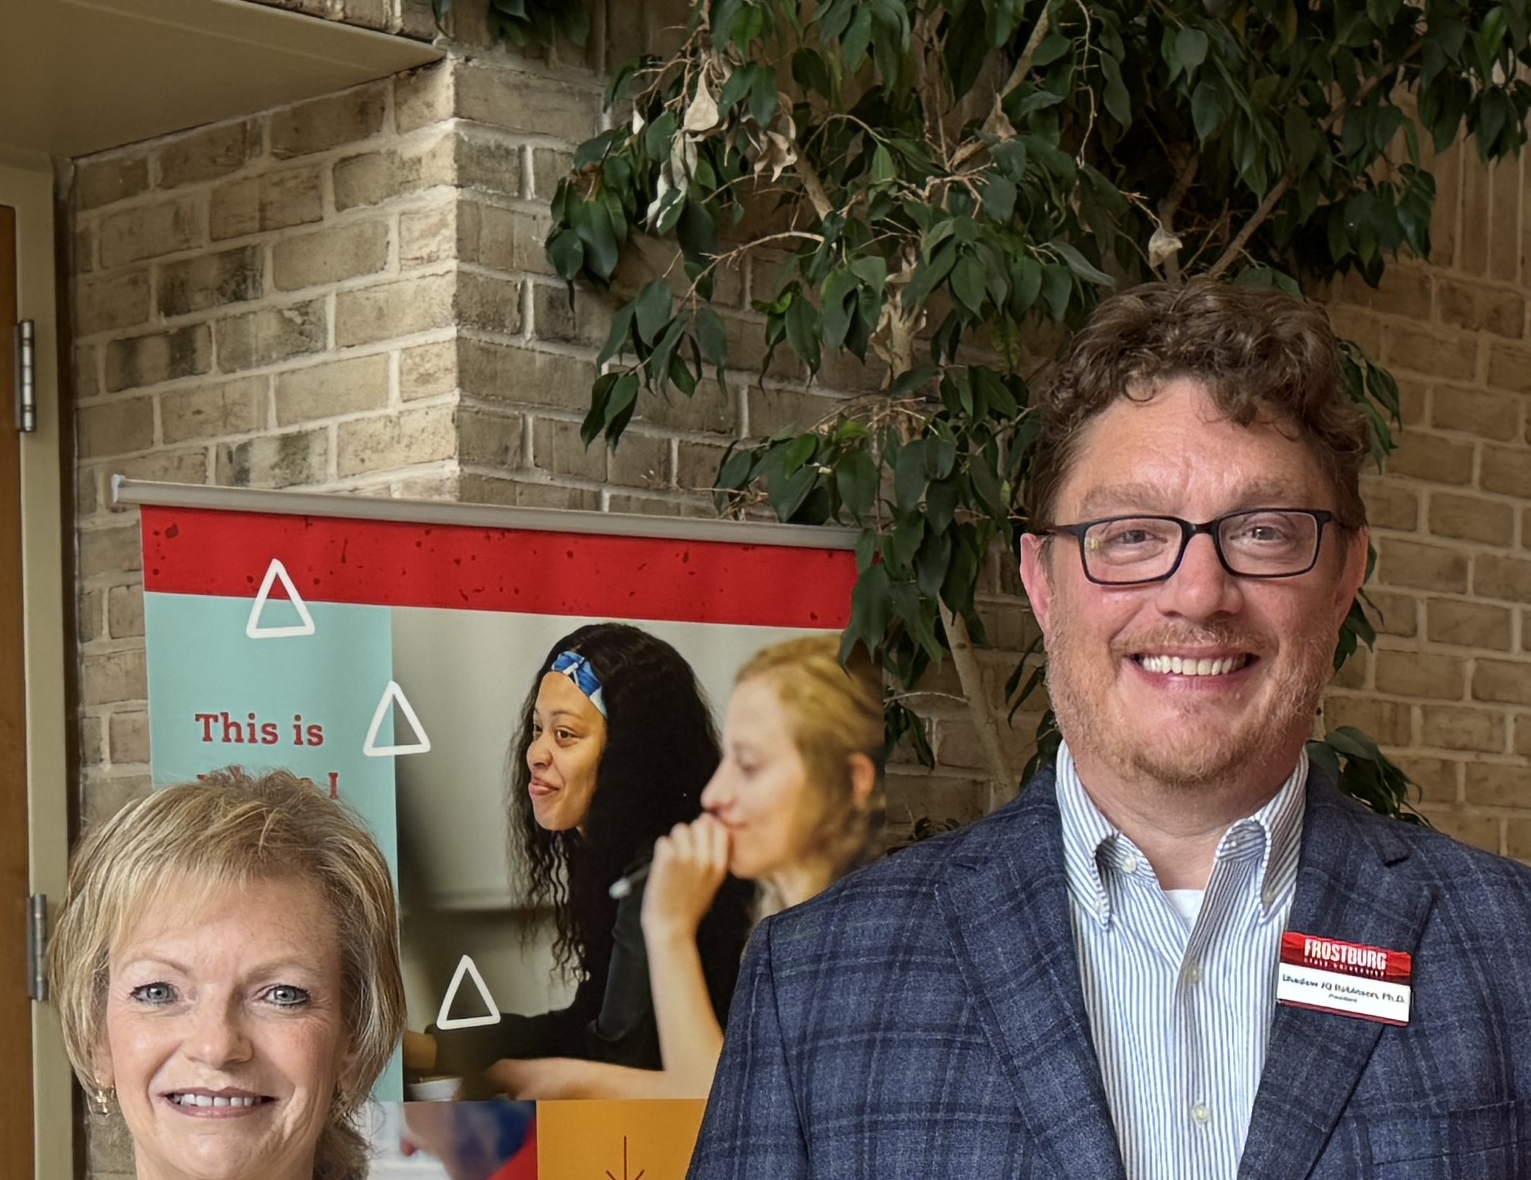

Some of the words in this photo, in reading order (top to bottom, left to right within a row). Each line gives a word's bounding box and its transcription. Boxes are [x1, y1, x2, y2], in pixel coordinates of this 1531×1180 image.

[195, 712, 279, 745] This
[293, 714, 324, 747] is
[1304, 938, 1387, 971] FROSTBURG
